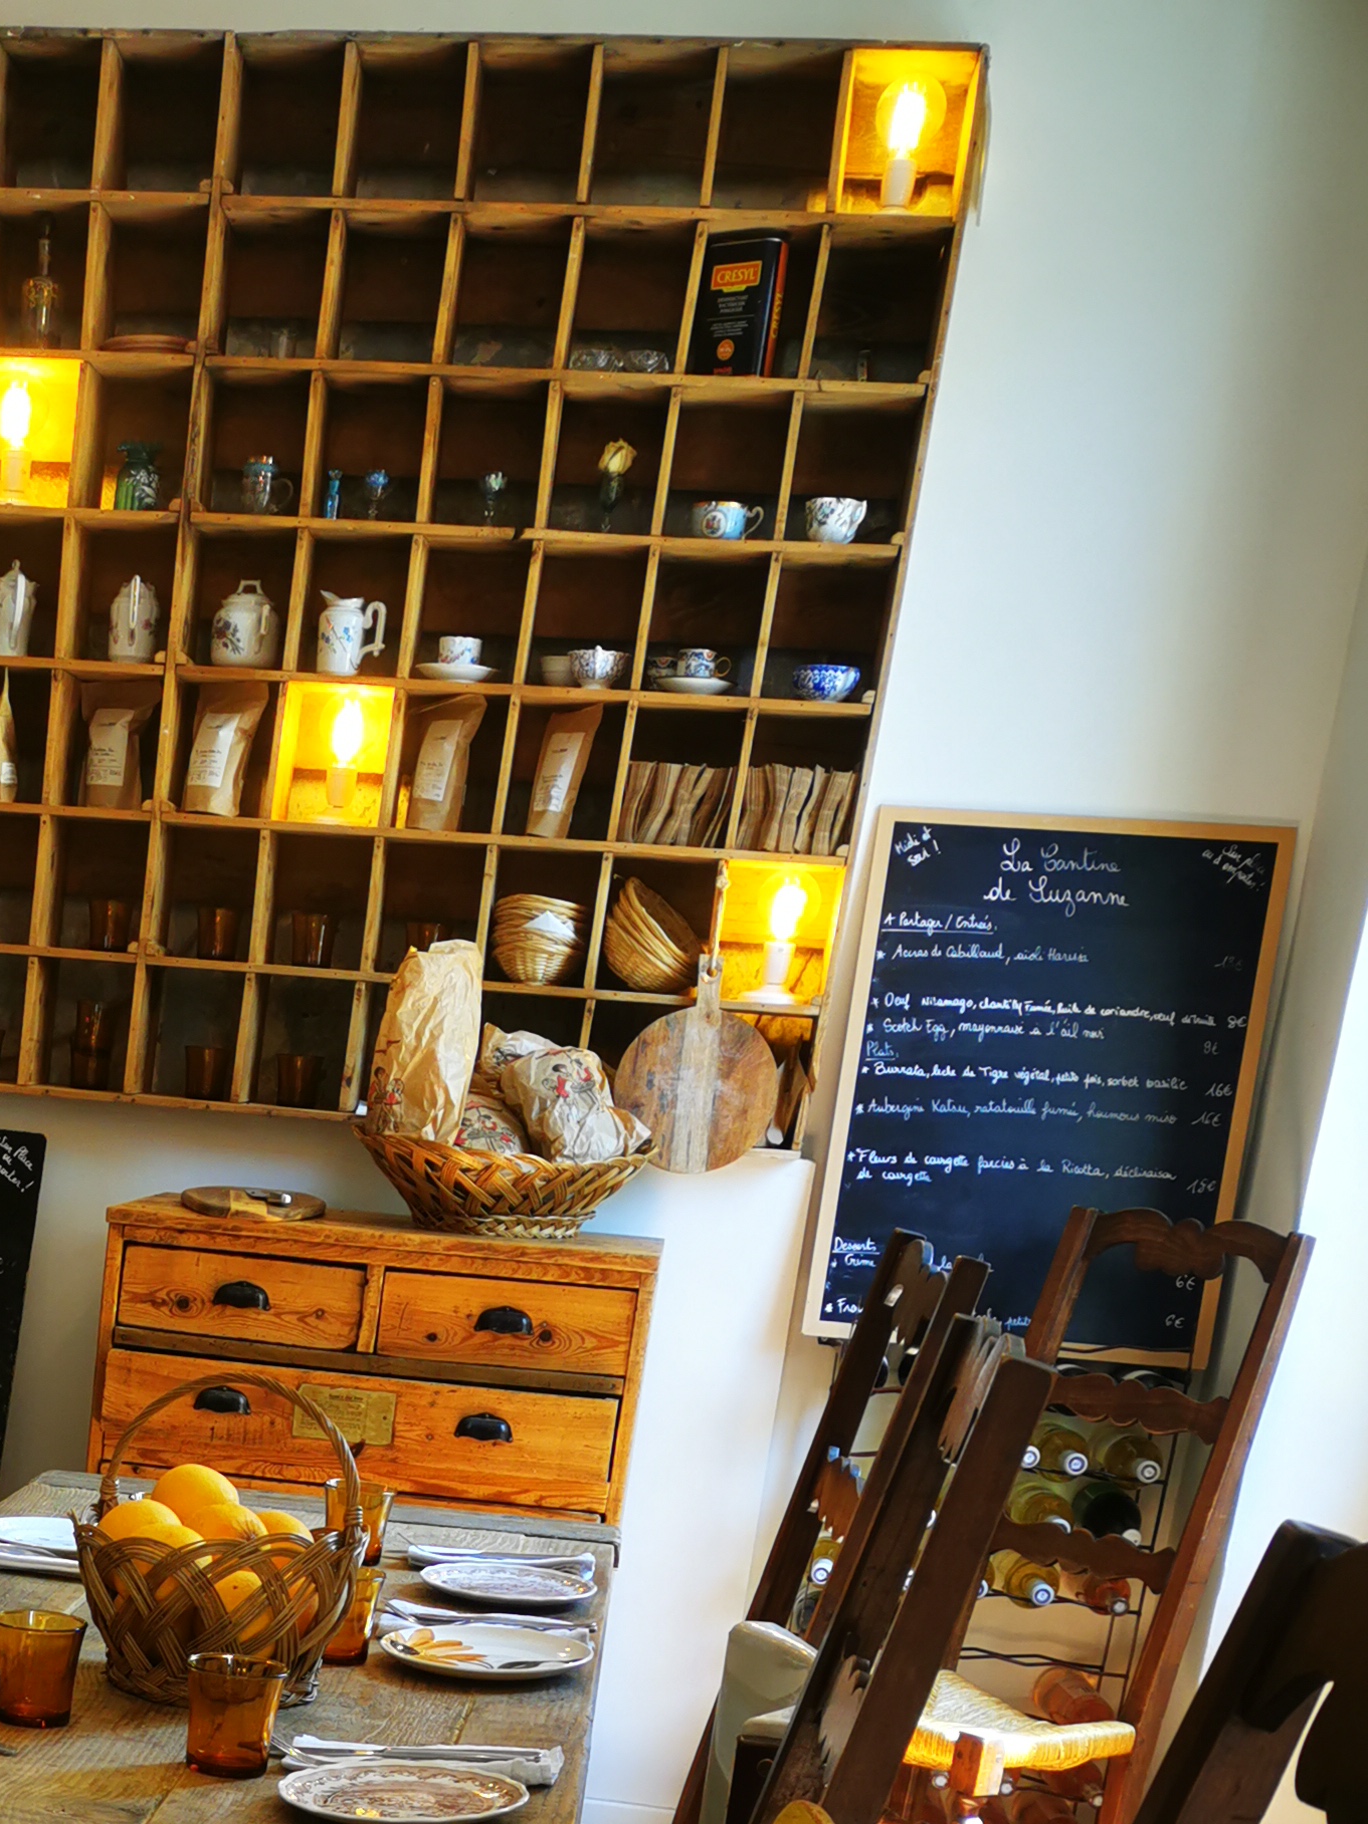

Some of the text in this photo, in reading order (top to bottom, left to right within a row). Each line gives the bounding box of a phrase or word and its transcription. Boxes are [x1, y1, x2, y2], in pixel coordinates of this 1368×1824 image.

[716, 268, 757, 284] CRESYL
[999, 837, 1122, 873] La Cantine
[982, 875, 1130, 918] de Suzanne
[882, 1017, 923, 1034] Scotch
[924, 1019, 956, 1042] Egg,
[873, 1060, 930, 1079] Burrata,
[857, 1147, 898, 1165] Fleurs
[903, 1151, 918, 1165] de
[855, 1166, 872, 1181] de
